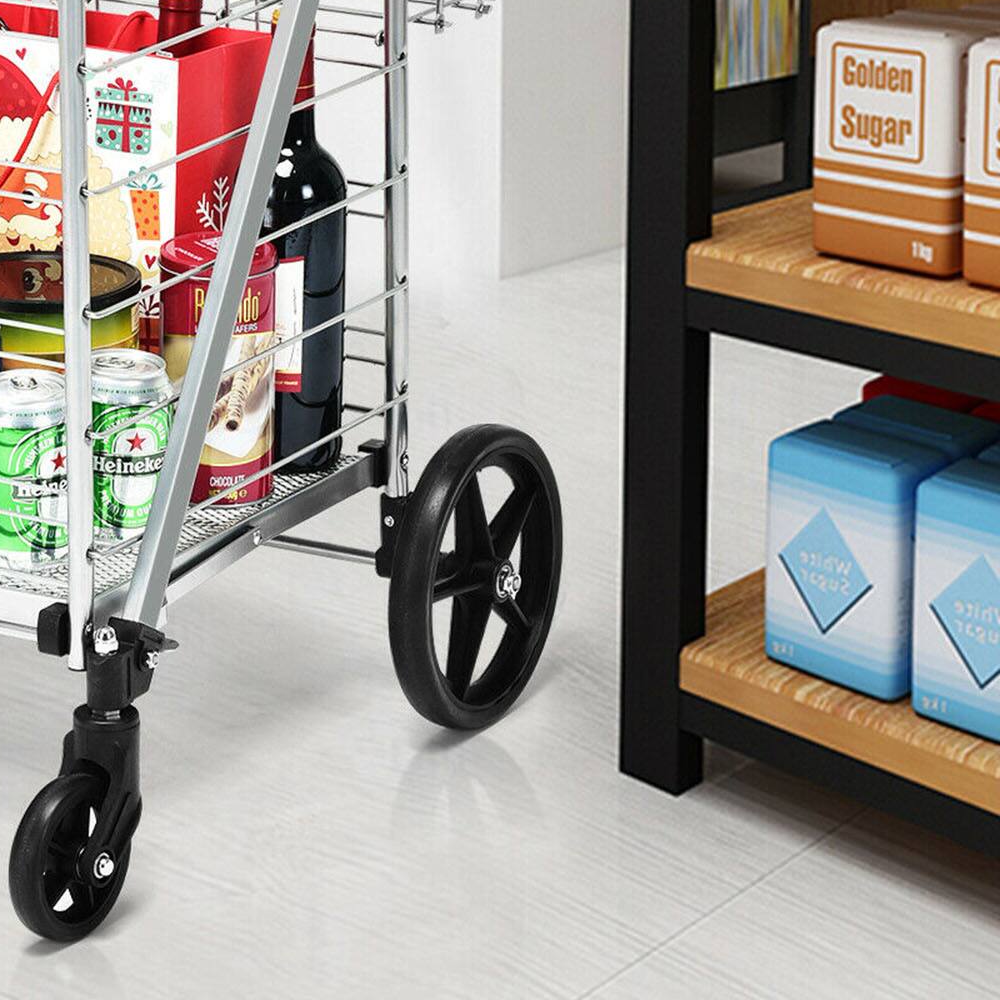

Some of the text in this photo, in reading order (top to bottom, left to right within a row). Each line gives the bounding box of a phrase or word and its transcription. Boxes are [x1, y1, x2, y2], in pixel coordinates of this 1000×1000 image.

[842, 55, 914, 94] Golden
[841, 104, 912, 148] Sugar
[93, 454, 165, 474] Heineke
[16, 478, 69, 497] Heine
